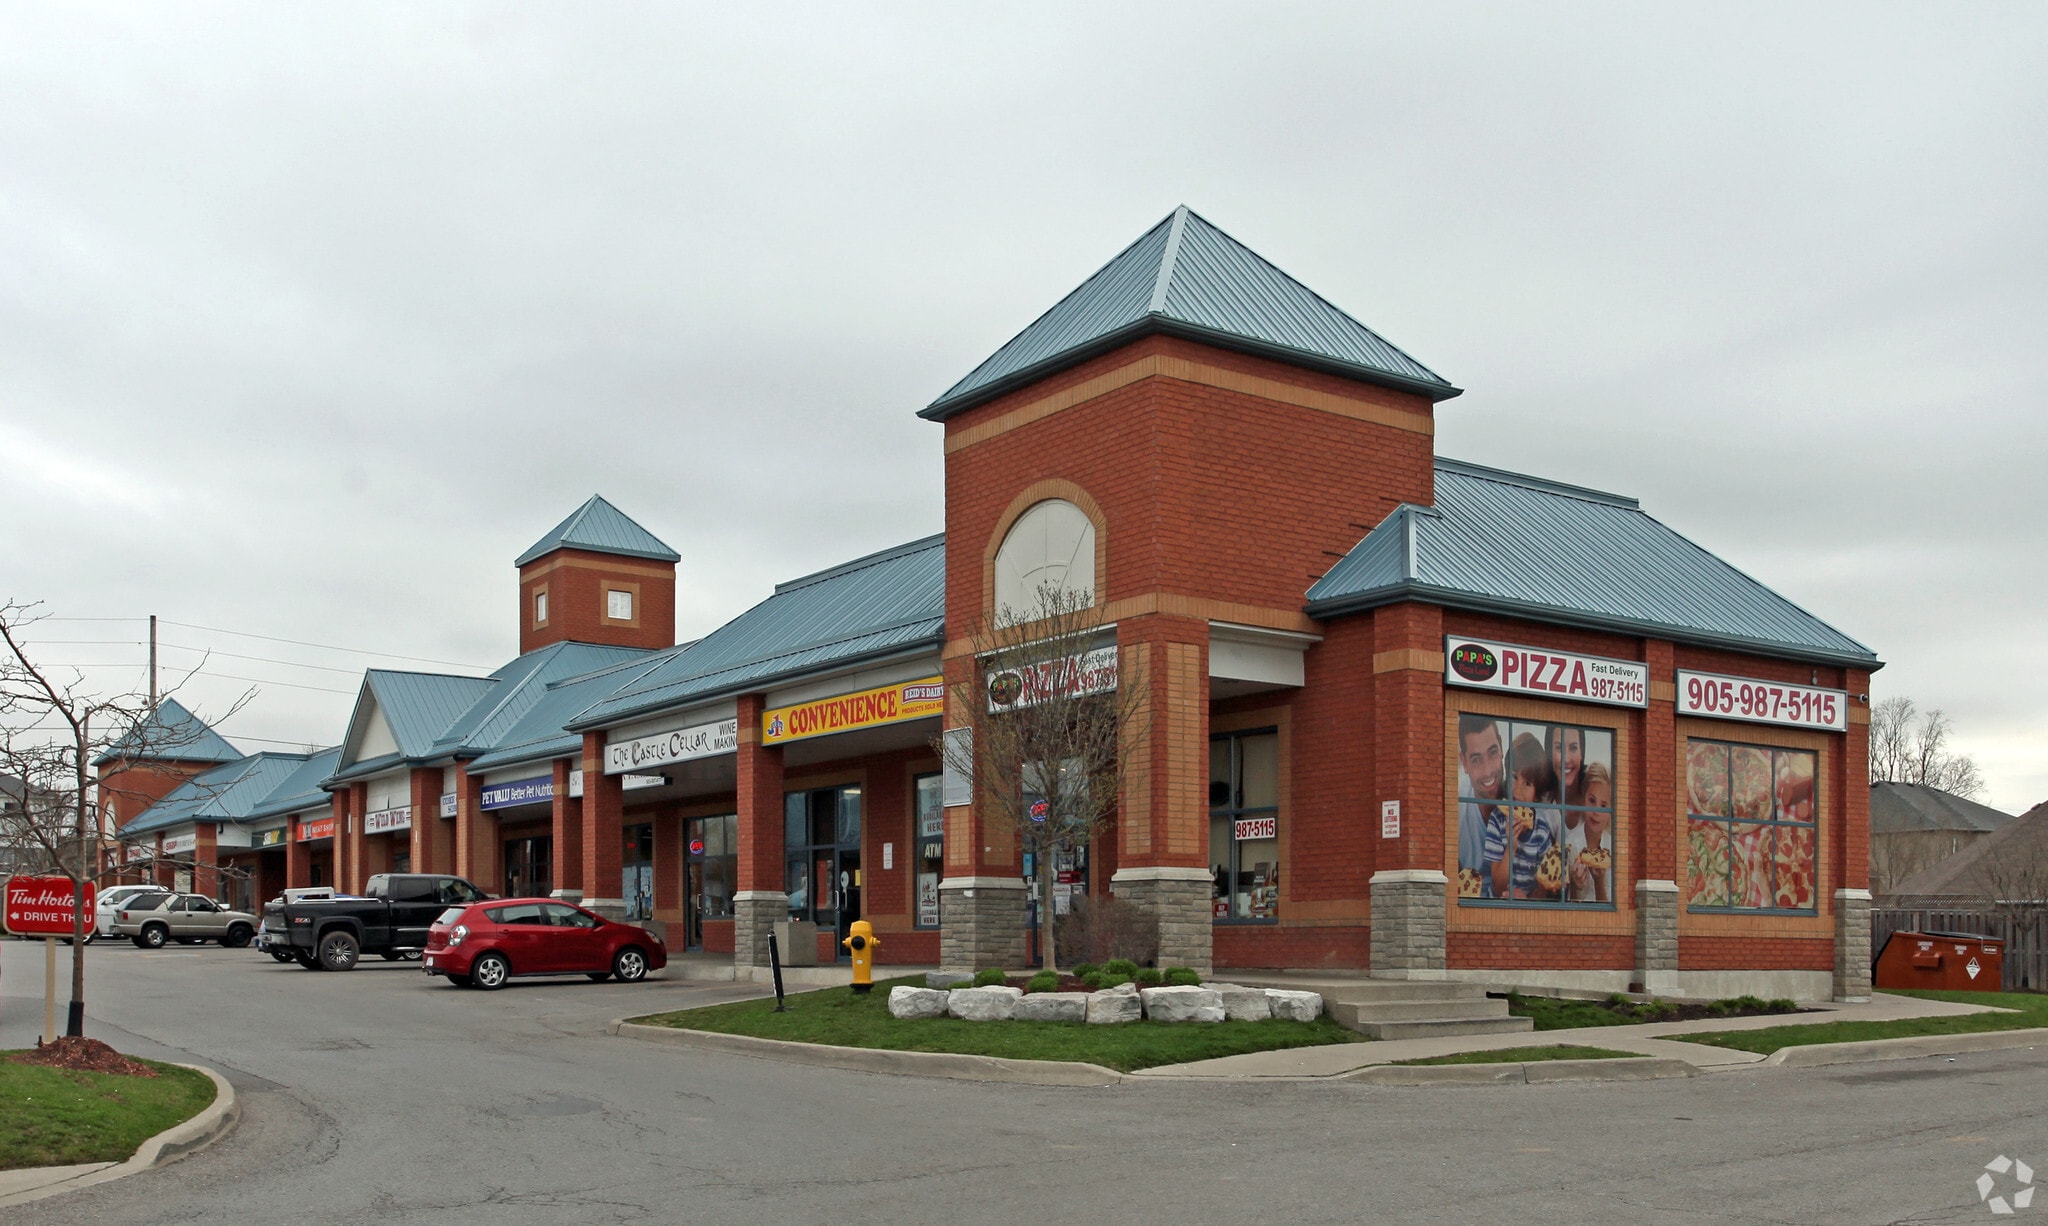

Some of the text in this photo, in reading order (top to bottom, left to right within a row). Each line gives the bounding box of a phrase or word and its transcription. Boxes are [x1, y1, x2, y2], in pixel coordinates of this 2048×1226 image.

[1456, 650, 1492, 666] PAPA'S
[1502, 650, 1588, 696] PIZZA
[1591, 663, 1639, 680] Fast Delivery
[1591, 677, 1644, 703] 987-5115
[1688, 677, 1836, 725] 905-987-5115
[789, 690, 897, 735] CONVENIENCE
[719, 722, 736, 736] WINE
[482, 791, 493, 805] PET
[494, 788, 510, 803] VALU
[511, 787, 526, 800] Better
[526, 785, 535, 798] Pet
[924, 844, 942, 858] ATM
[10, 889, 91, 907] Tim Hortos
[24, 912, 92, 923] DRIVE THU
